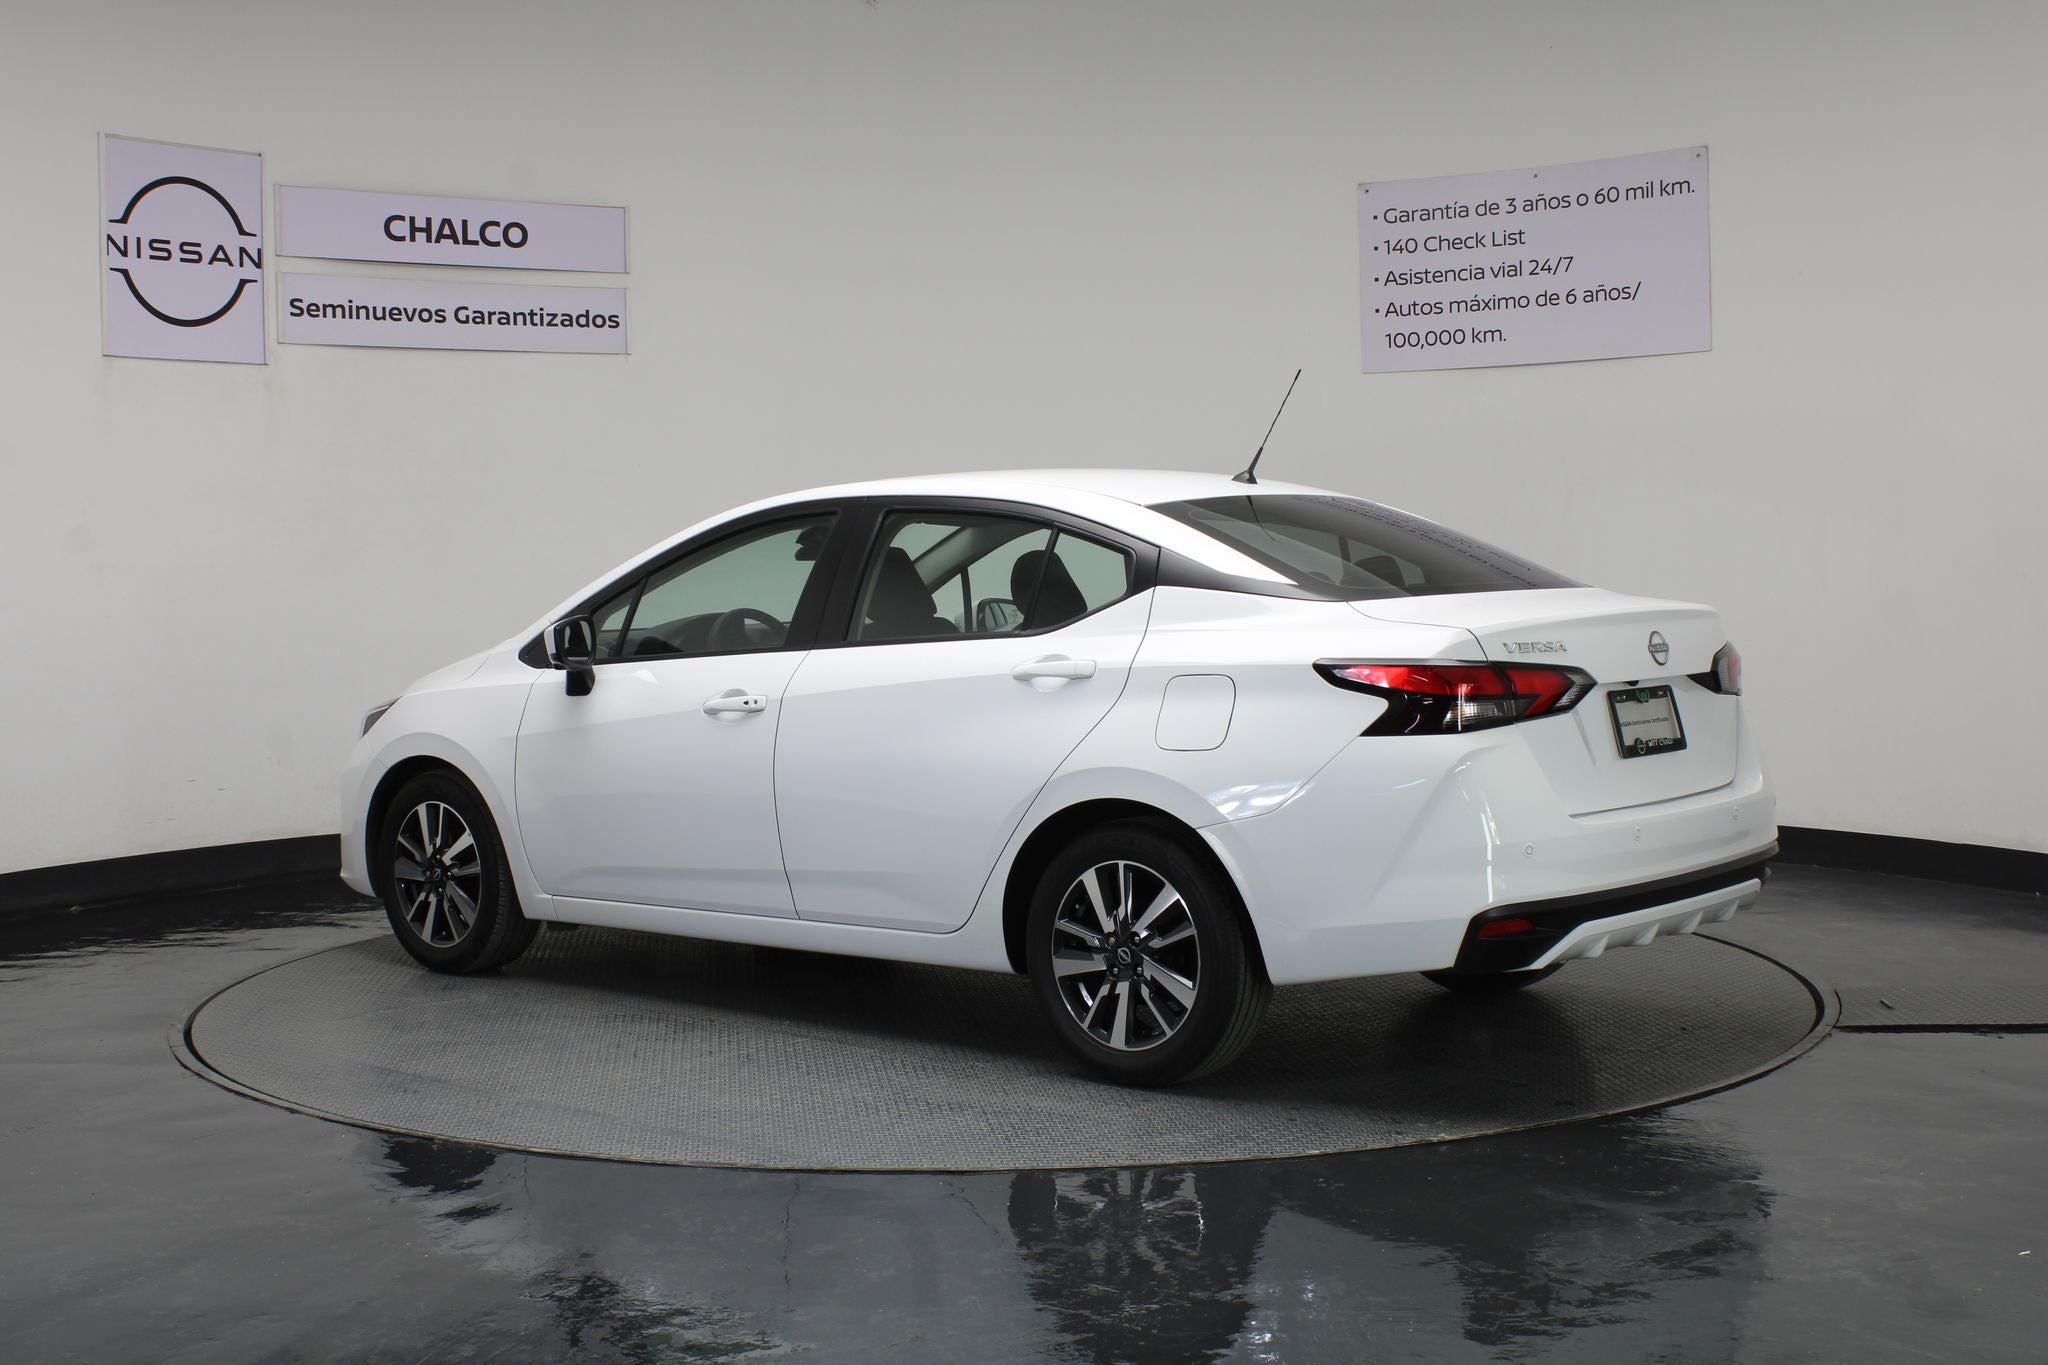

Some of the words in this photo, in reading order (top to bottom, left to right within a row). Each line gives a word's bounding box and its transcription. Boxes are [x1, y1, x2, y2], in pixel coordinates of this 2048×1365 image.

[1383, 200, 1469, 225] Garantía
[1475, 199, 1500, 217] de
[1505, 197, 1517, 215] 3
[1522, 193, 1572, 213] años
[1576, 193, 1589, 207] o
[1594, 186, 1620, 205] 60
[1625, 180, 1654, 201] mil
[1659, 179, 1695, 197] km.
[383, 214, 528, 249] CHALCO
[1383, 238, 1419, 256] 140
[1423, 231, 1487, 253] Check
[1491, 228, 1527, 248] List
[107, 233, 263, 271] NISSAN
[1383, 264, 1485, 287] Asistencia
[1489, 259, 1523, 279] vial
[1528, 255, 1574, 276] 24/7
[289, 297, 447, 324] Seminuevos
[453, 305, 621, 330] Garantizados
[1384, 299, 1444, 318] Autos
[1449, 292, 1531, 314] máximo
[1535, 289, 1560, 308] de
[1565, 288, 1578, 305] 6
[1582, 280, 1642, 304] años/
[1384, 328, 1466, 350] 100,000
[1471, 327, 1507, 345] km.
[1502, 640, 1569, 654] VERSA
